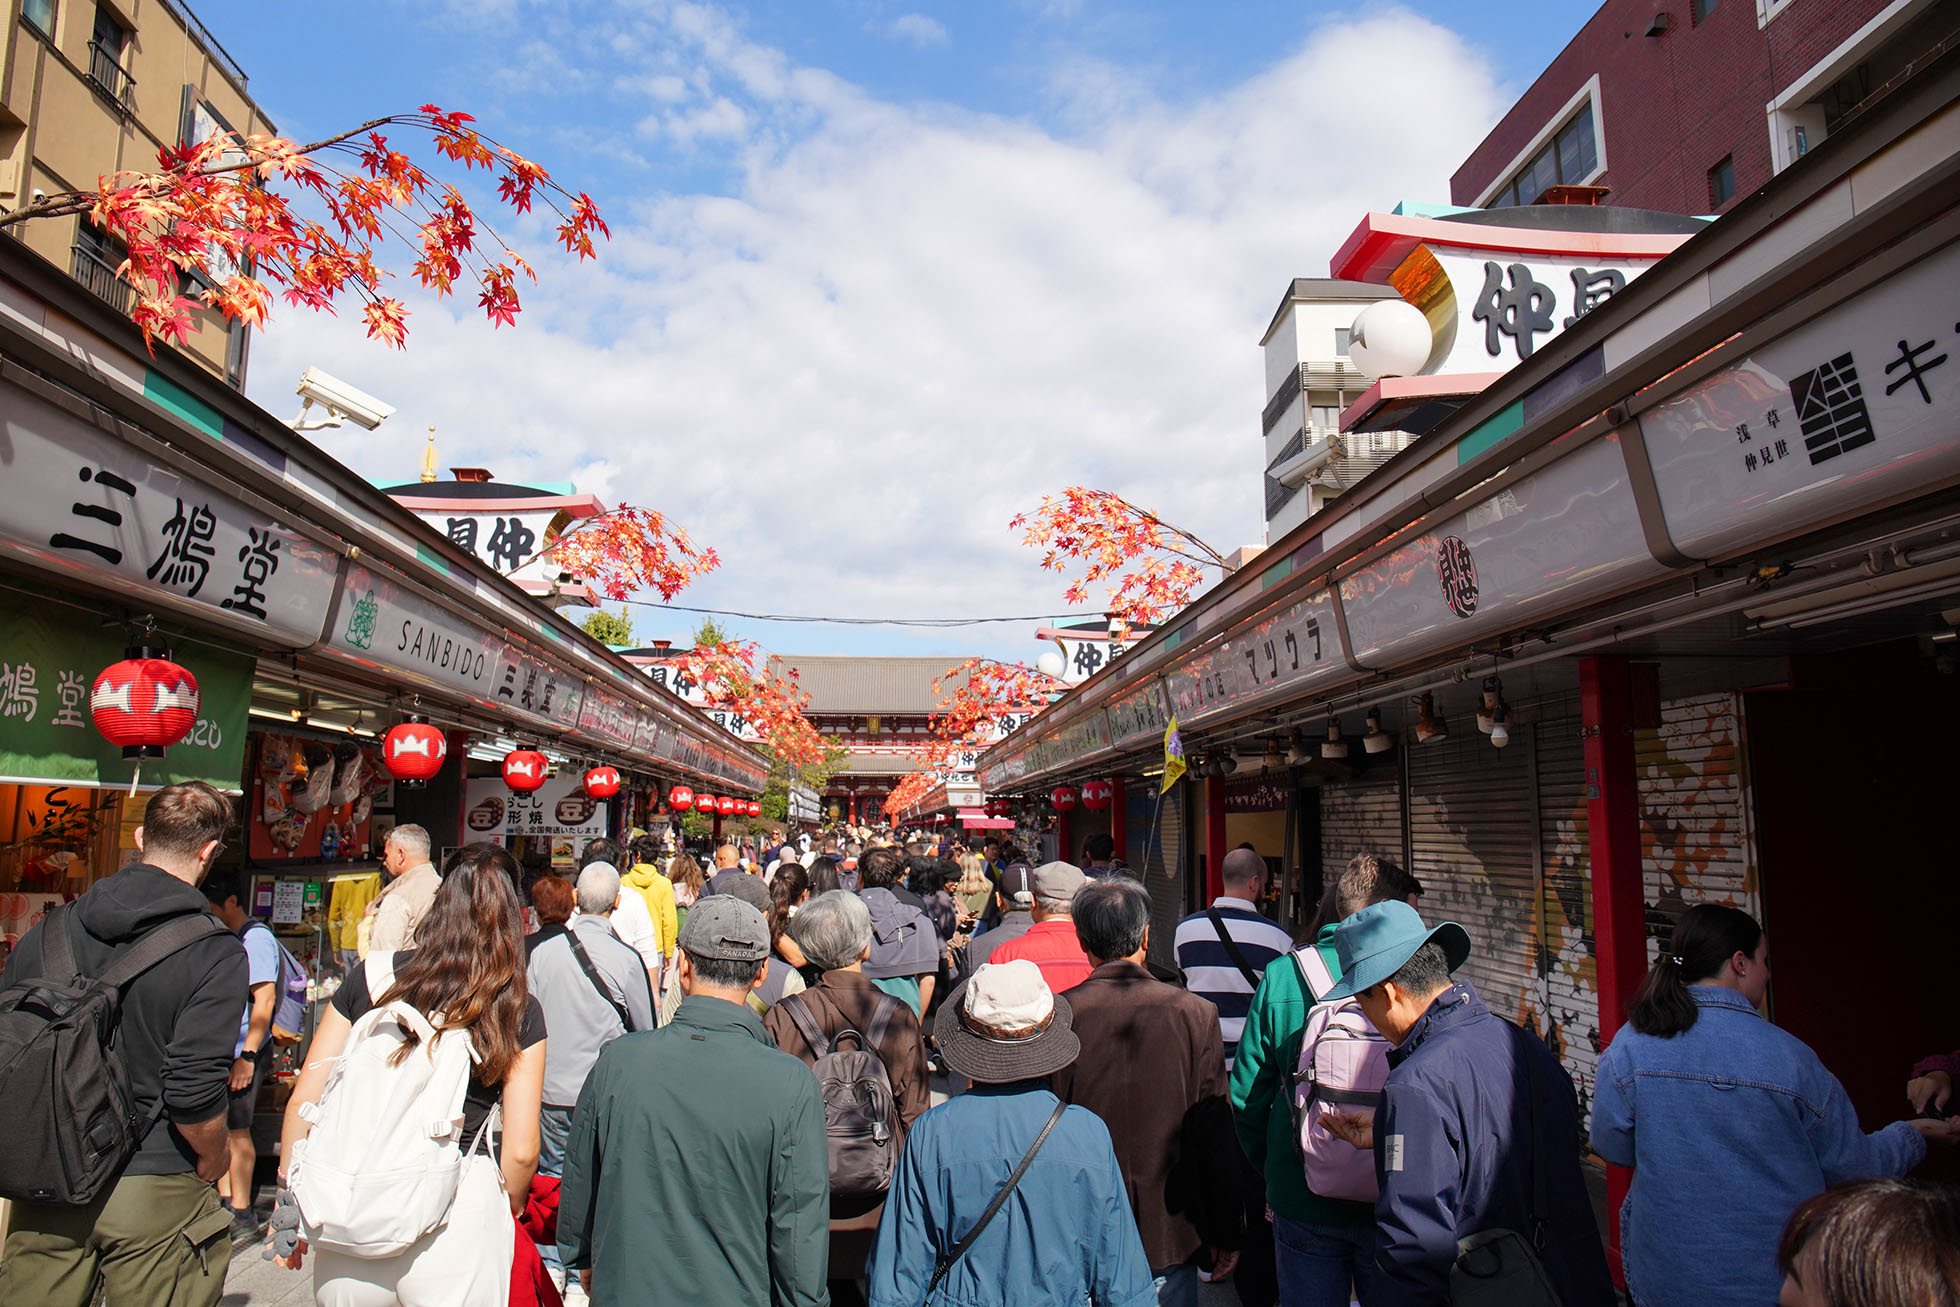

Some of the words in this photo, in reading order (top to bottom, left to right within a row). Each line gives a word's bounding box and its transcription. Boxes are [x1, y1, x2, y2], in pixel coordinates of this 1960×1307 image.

[1885, 322, 1960, 404] キ
[1735, 409, 1780, 443] 浅草
[1744, 439, 1790, 473] 仲見世
[50, 466, 281, 621] 三鳩堂
[398, 619, 484, 680] SANBIDO
[1245, 617, 1321, 684] マツウラ
[529, 826, 600, 835] 全国発送いたします
[722, 949, 752, 957] CANADA
